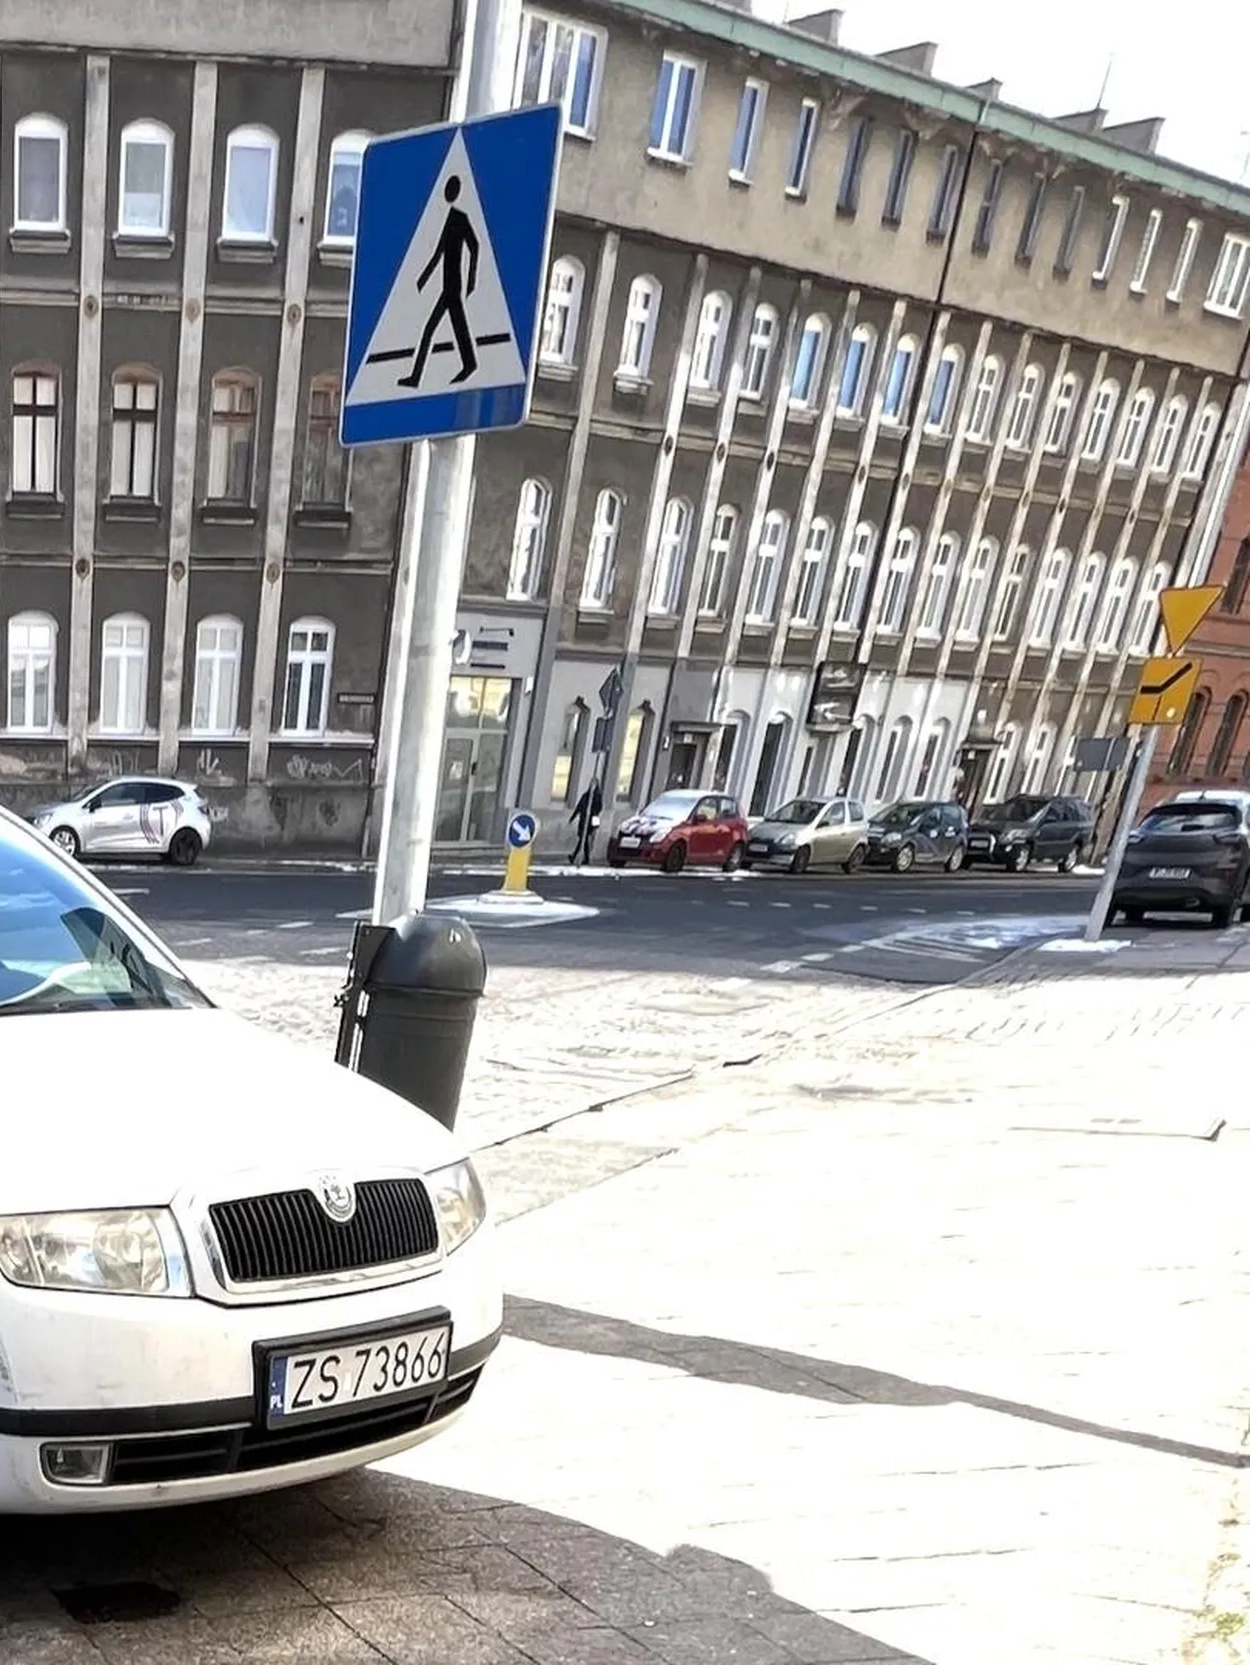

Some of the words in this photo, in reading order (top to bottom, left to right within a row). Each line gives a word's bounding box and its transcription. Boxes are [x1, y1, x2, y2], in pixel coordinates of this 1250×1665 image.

[291, 1355, 342, 1409] ZS
[352, 1332, 445, 1397] 73866
[270, 1394, 283, 1410] PL
